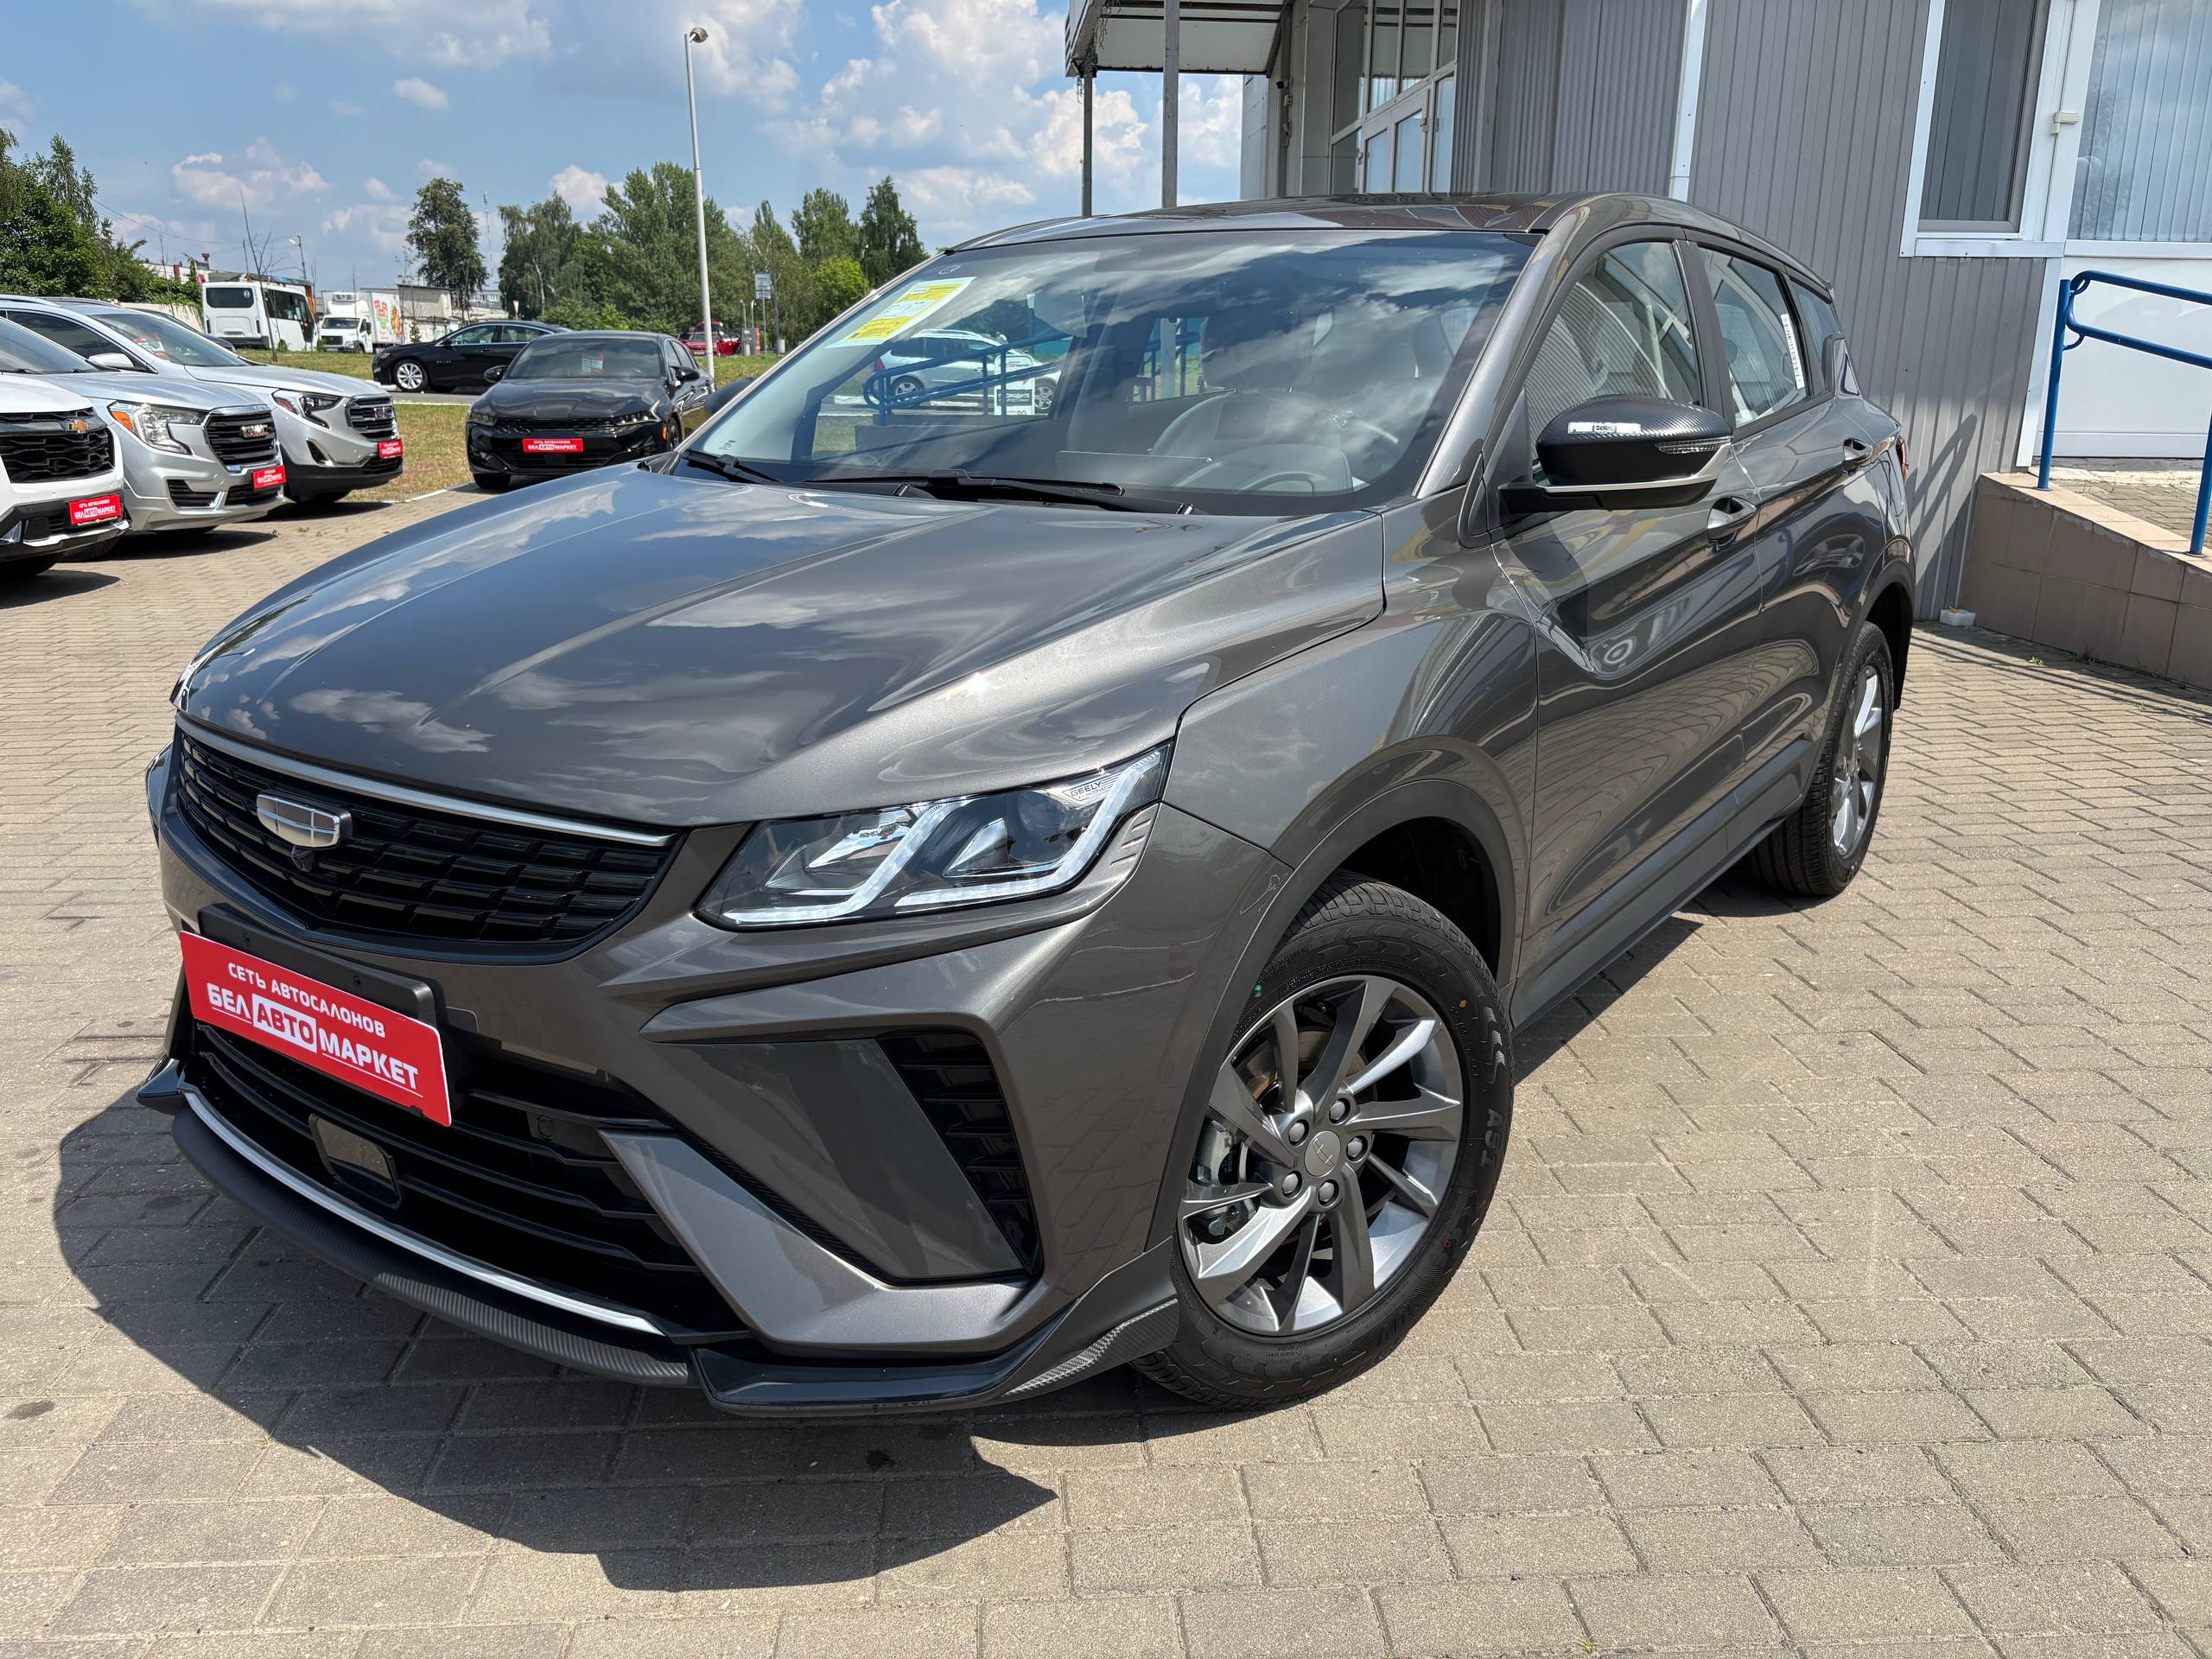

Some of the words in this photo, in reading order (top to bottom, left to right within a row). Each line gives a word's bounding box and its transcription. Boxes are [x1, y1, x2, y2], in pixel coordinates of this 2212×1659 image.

[1071, 781, 1102, 796] GEELY
[228, 962, 267, 990] СЕТЬ
[270, 978, 386, 1039] АВТОСАЛОНОВ
